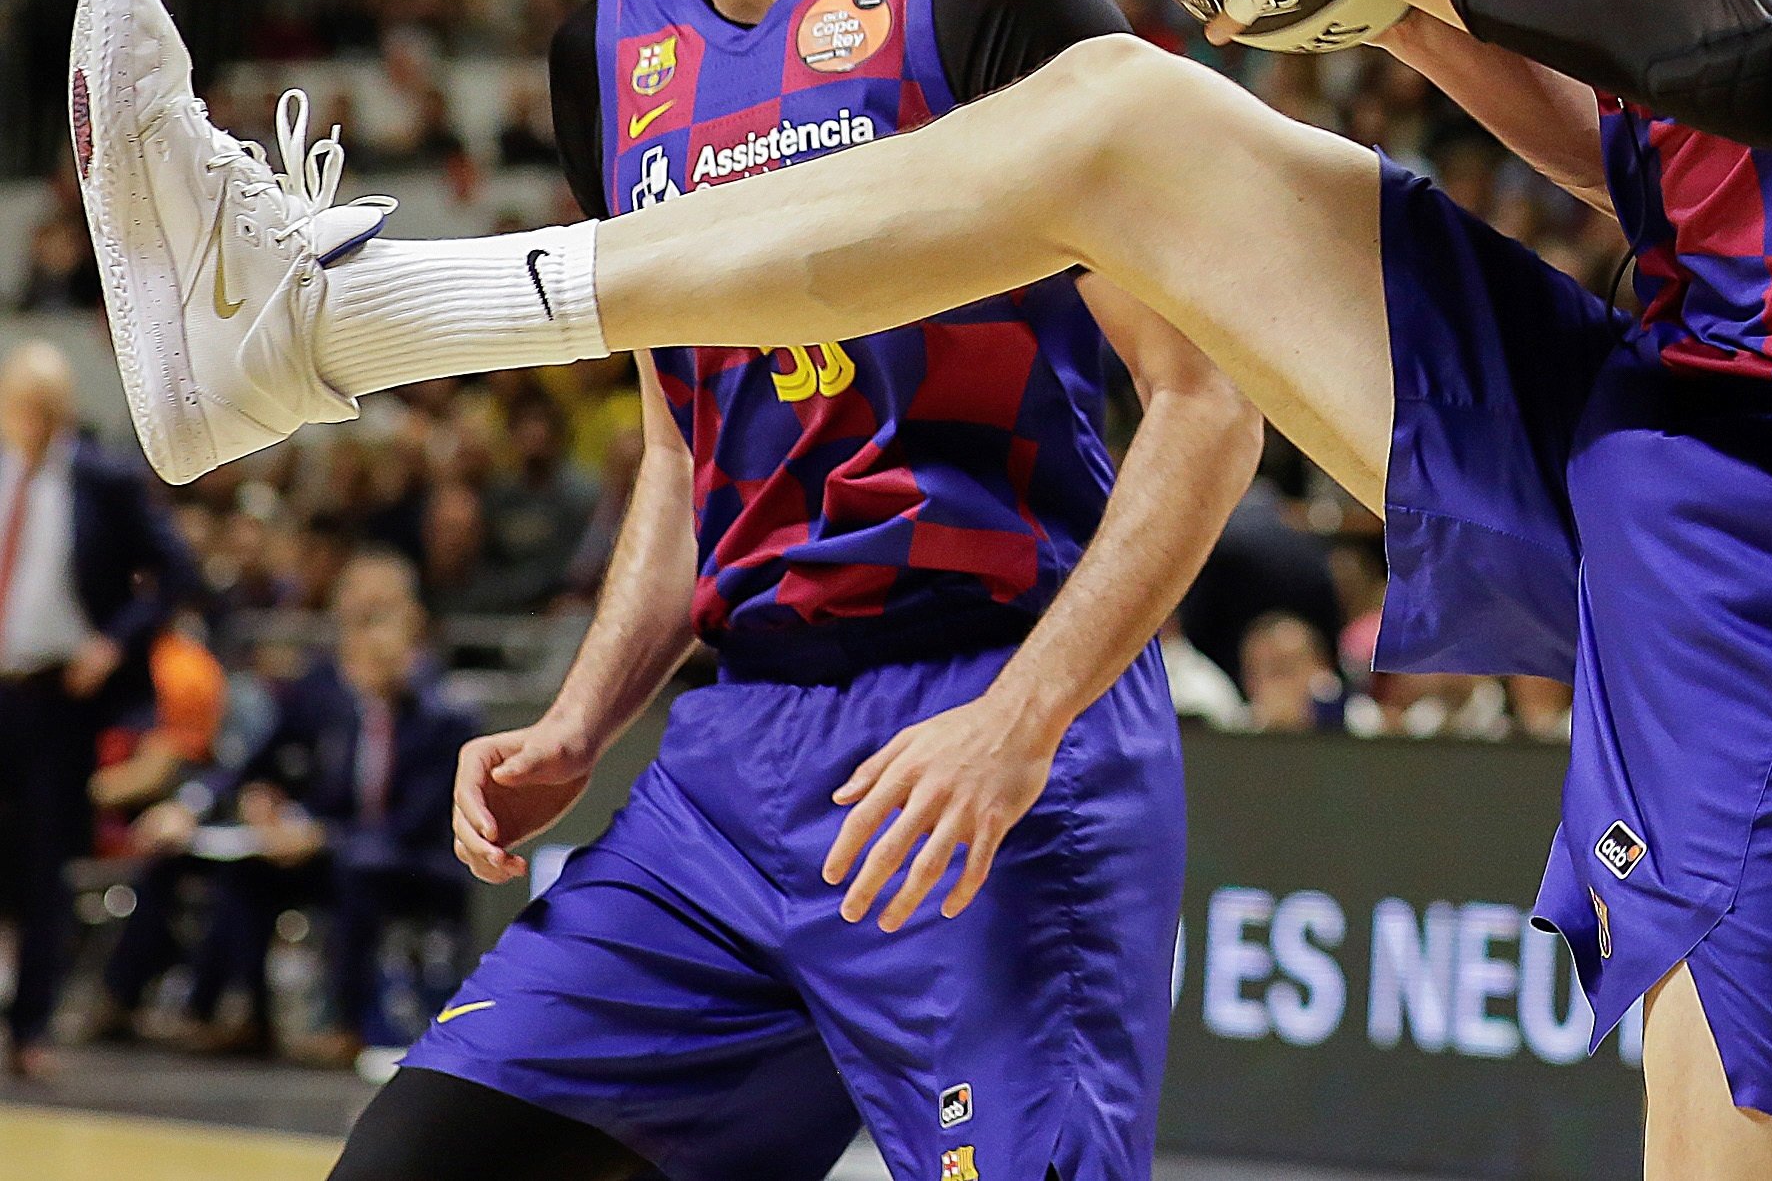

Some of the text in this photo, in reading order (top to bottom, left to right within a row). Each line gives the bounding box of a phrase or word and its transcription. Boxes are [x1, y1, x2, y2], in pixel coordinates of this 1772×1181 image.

[812, 19, 860, 38] Copa
[692, 108, 875, 184] Assistència
[1601, 837, 1628, 868] acb
[1204, 885, 1348, 1046] ES
[1366, 896, 1644, 1068] NEU
